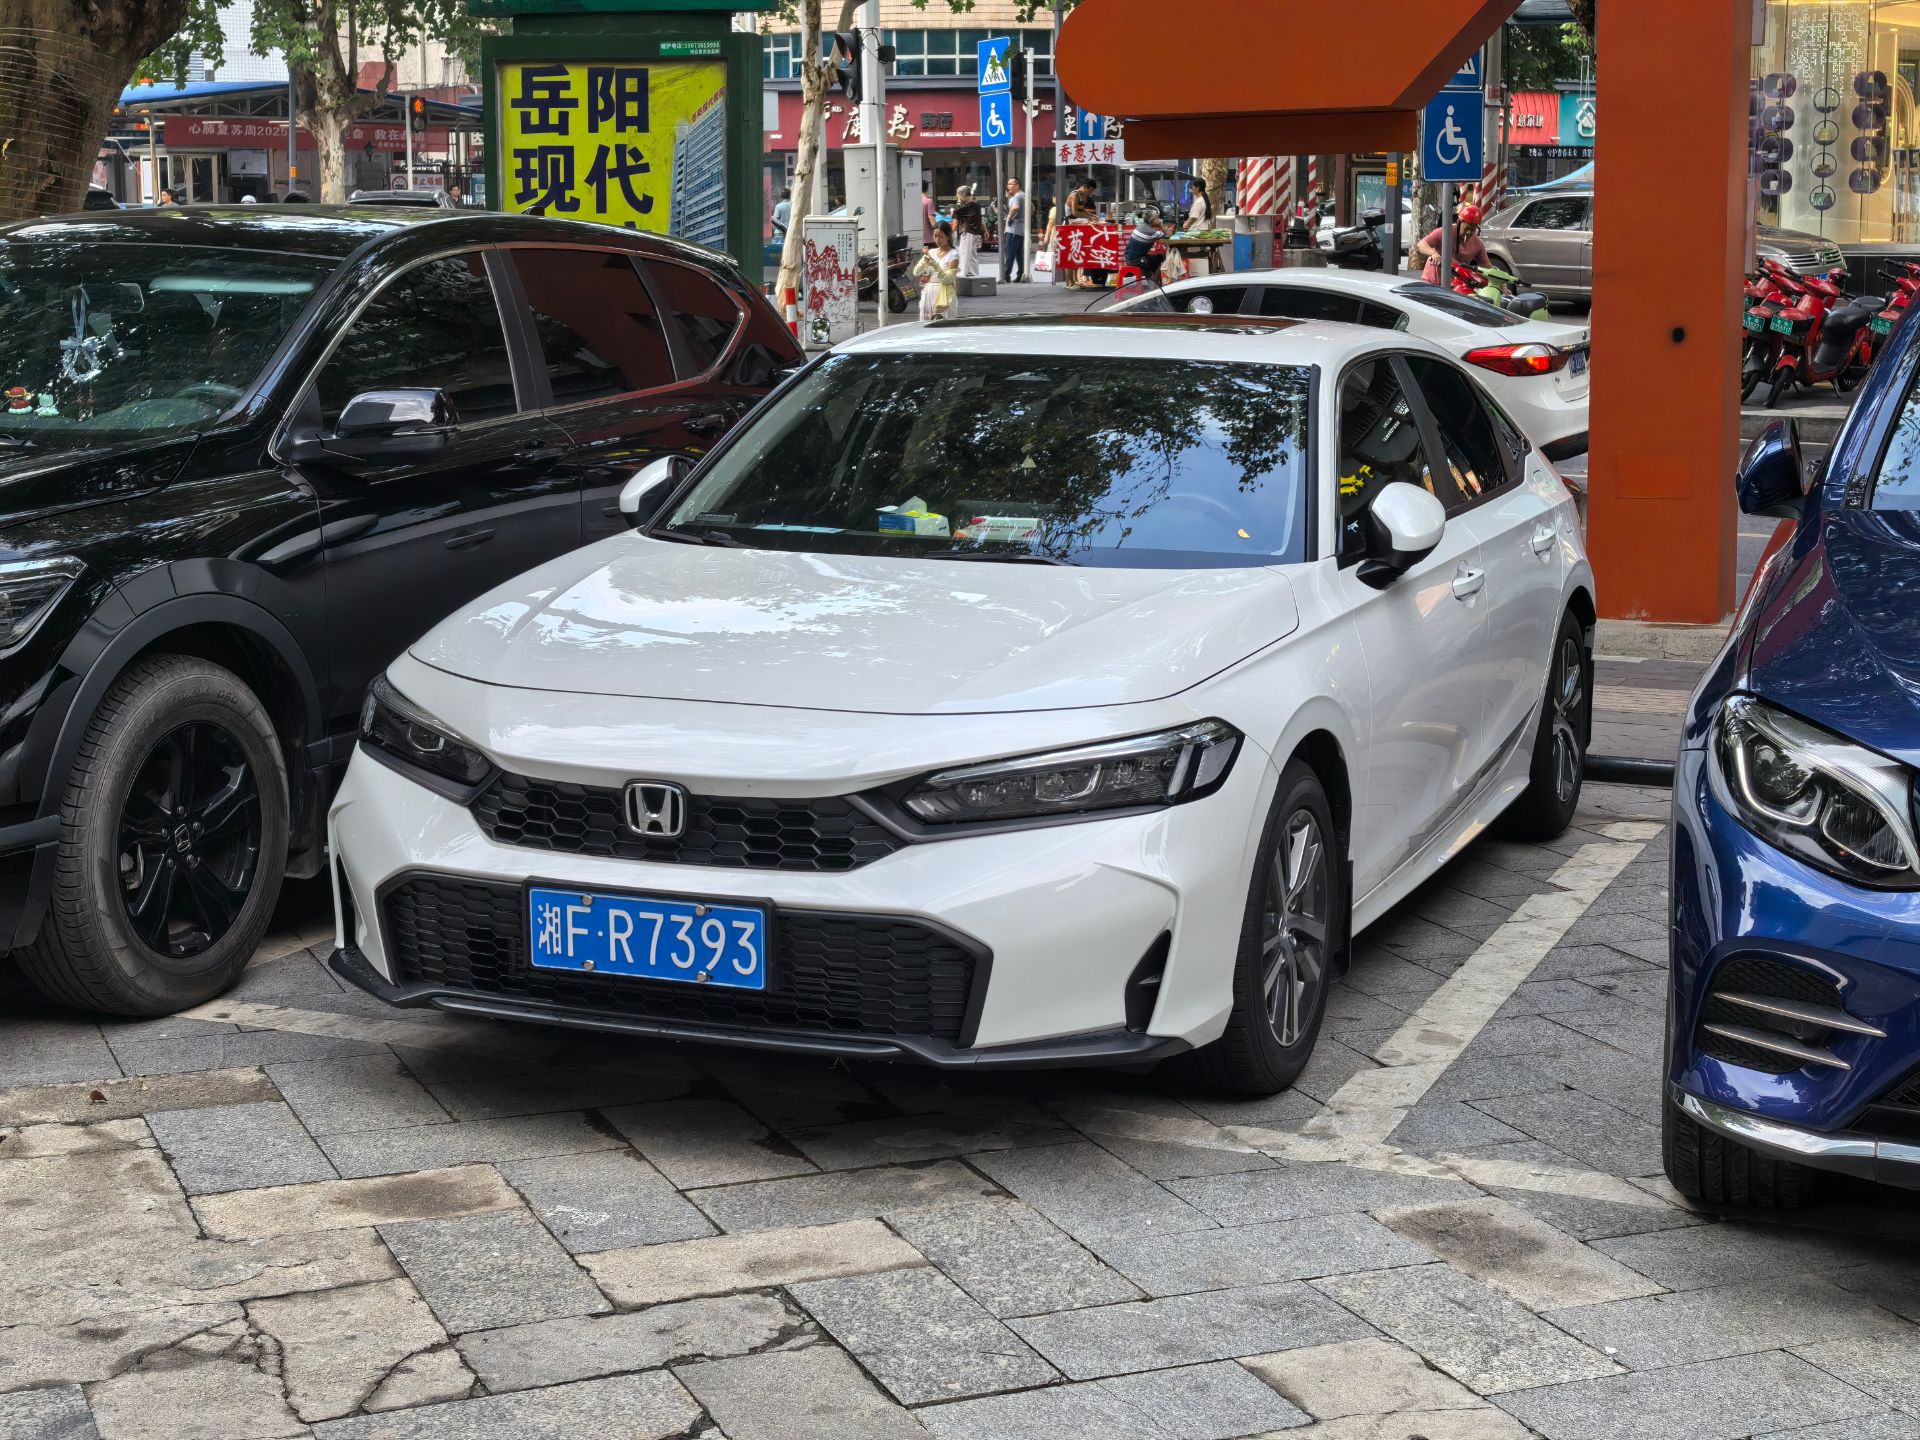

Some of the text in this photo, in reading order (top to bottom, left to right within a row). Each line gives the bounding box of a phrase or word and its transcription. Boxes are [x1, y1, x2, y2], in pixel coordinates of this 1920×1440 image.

[511, 64, 650, 136] 岳阳
[513, 143, 654, 214] 现代
[1058, 142, 1116, 164] 香葱大饼
[537, 902, 758, 976] 湘F·R7393
